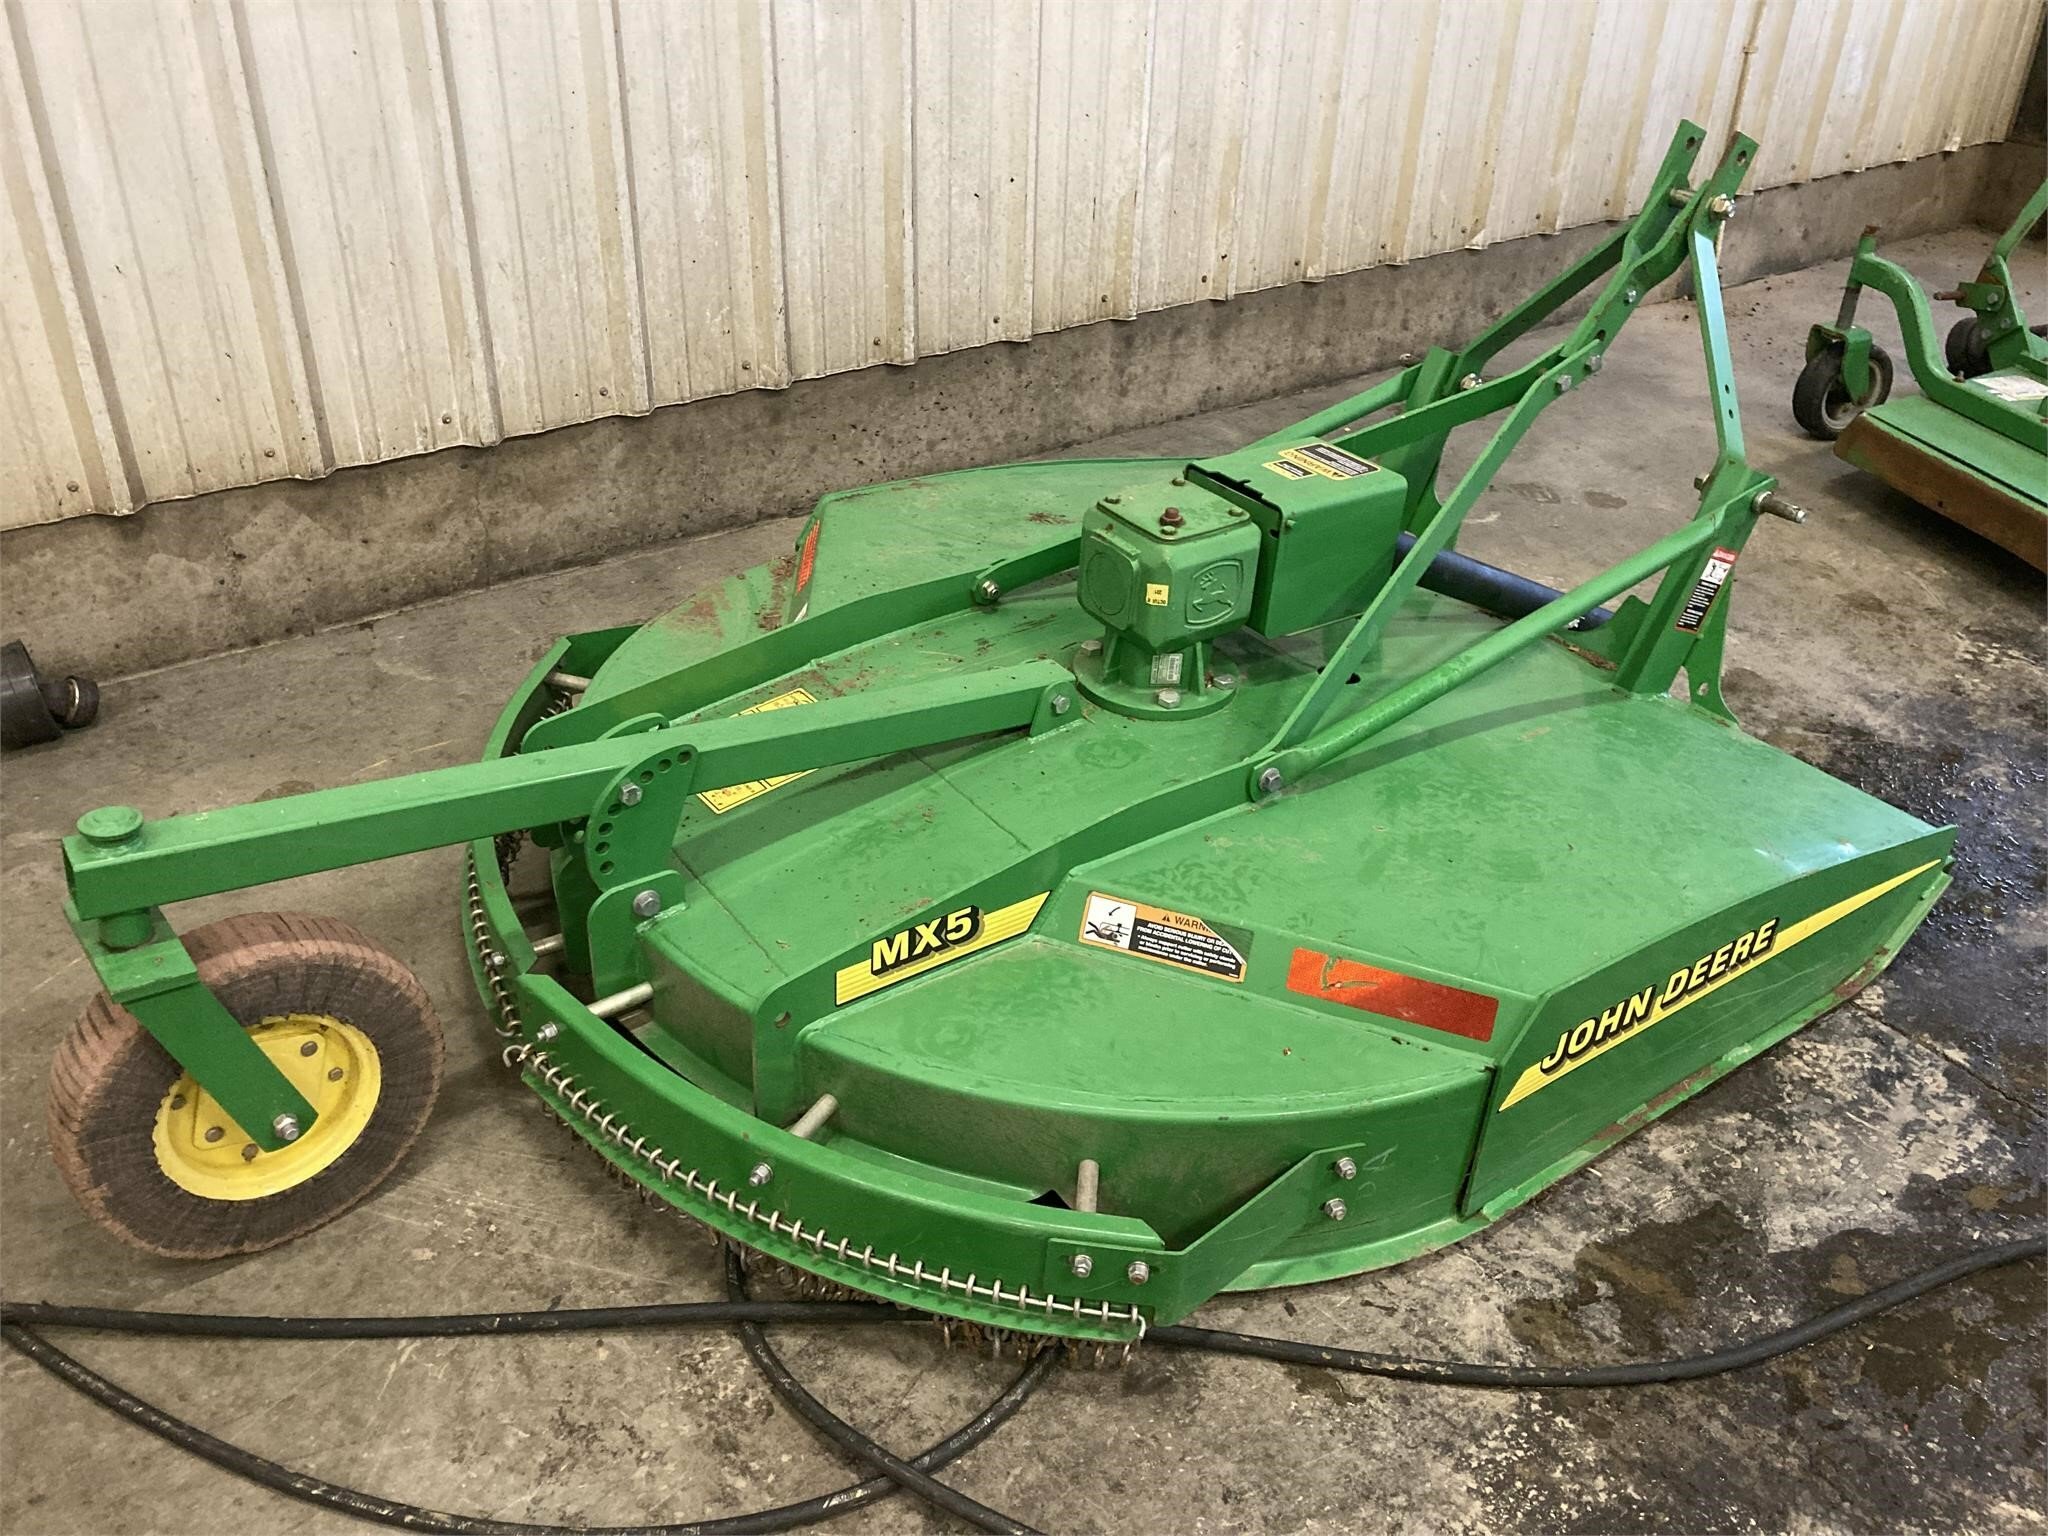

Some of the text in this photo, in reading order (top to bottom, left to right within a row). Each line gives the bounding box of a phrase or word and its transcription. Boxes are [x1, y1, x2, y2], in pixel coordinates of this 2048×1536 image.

[871, 905, 982, 976] MX5
[1175, 916, 1212, 933] WARN
[1540, 917, 1779, 1074] JOHN DEERE
